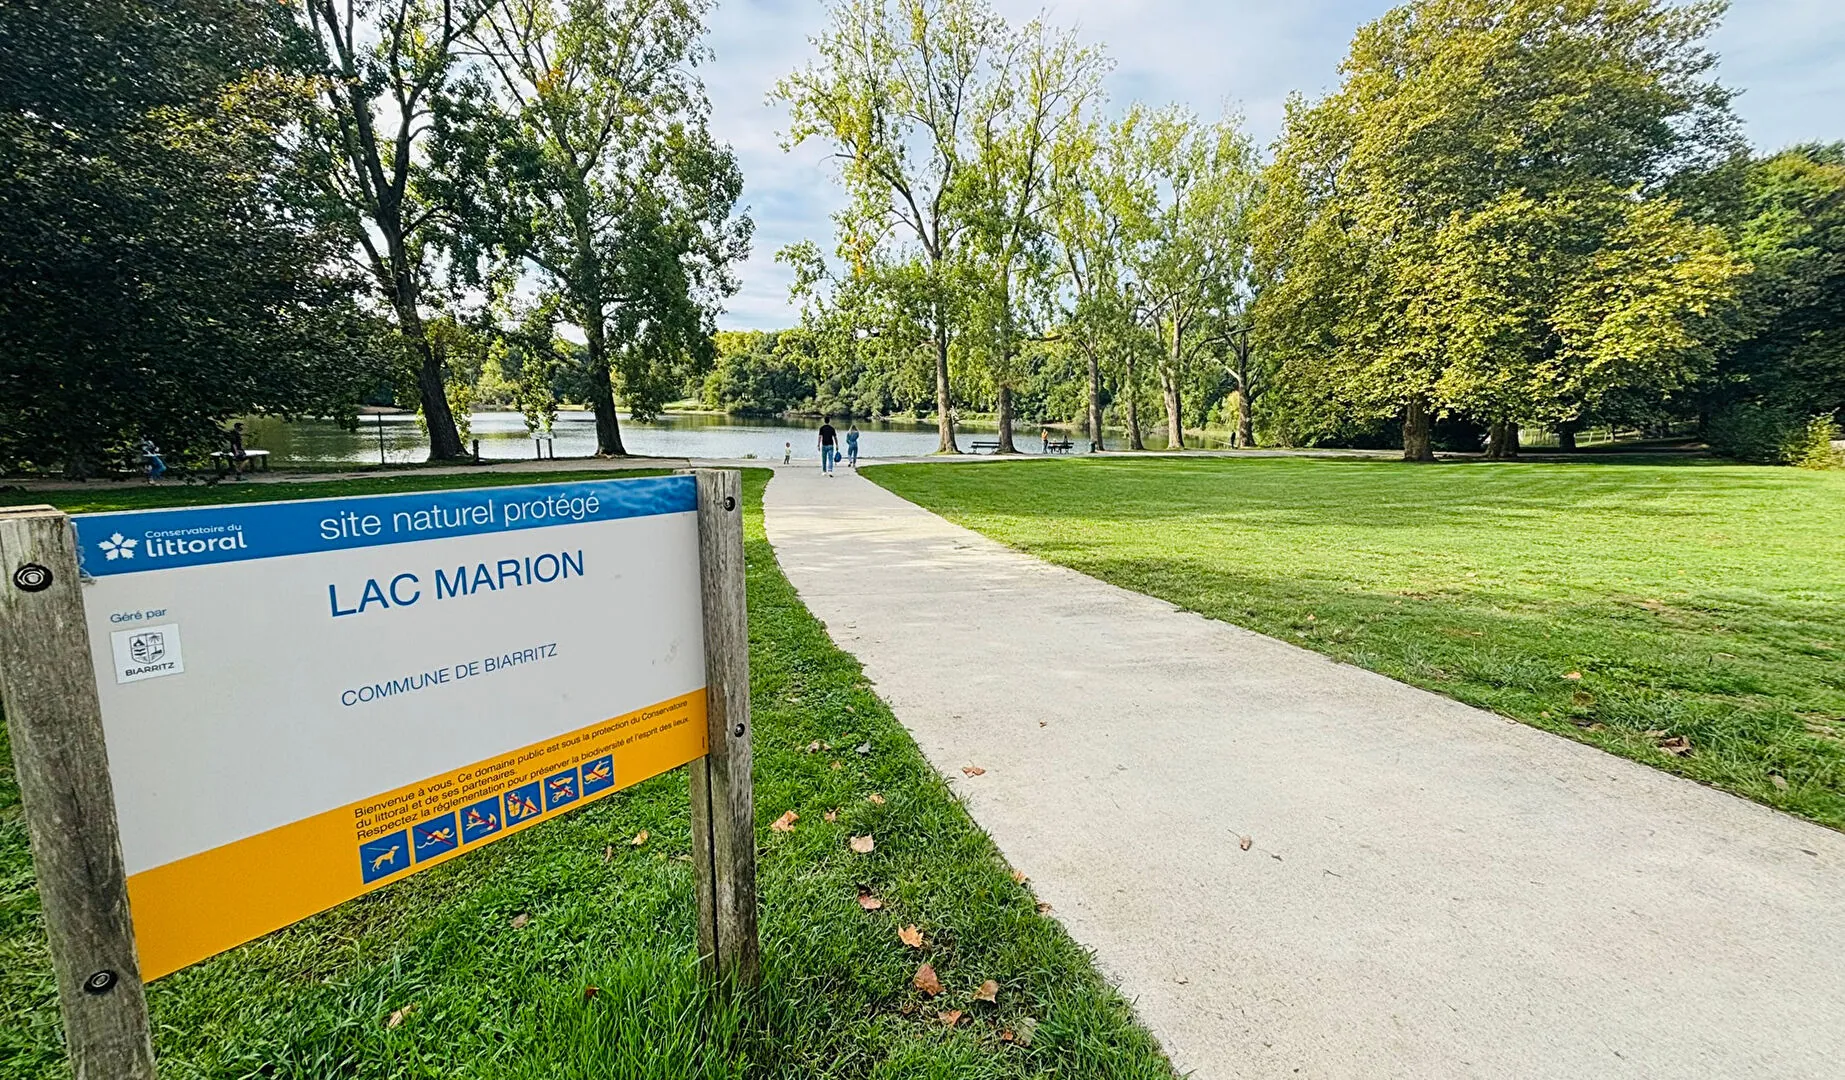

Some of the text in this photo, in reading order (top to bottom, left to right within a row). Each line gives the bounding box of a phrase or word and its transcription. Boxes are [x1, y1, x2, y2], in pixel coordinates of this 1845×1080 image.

[144, 524, 242, 538] Conservatoire du
[320, 491, 600, 540] site naturel protégé
[146, 532, 248, 558] littoral
[328, 549, 584, 617] LAC MARION
[110, 608, 167, 623] Géré par
[125, 662, 175, 676] BIARRITZ
[341, 643, 558, 706] COMMUNE DE BIARRITZ
[354, 700, 688, 818] Bienvenue à vous. Ce domaine public est sous la protection du Conservatoire
[357, 814, 418, 840] Respectez
[421, 807, 430, 816] la
[508, 775, 527, 788] pour
[530, 759, 570, 780] préserver
[572, 754, 579, 763] la
[581, 739, 625, 760] biodiversité
[626, 735, 633, 744] et
[660, 722, 672, 732] des
[356, 818, 371, 829] du
[376, 804, 408, 823] littoral
[412, 799, 422, 809] et
[425, 793, 438, 804] de
[442, 788, 459, 799] ses
